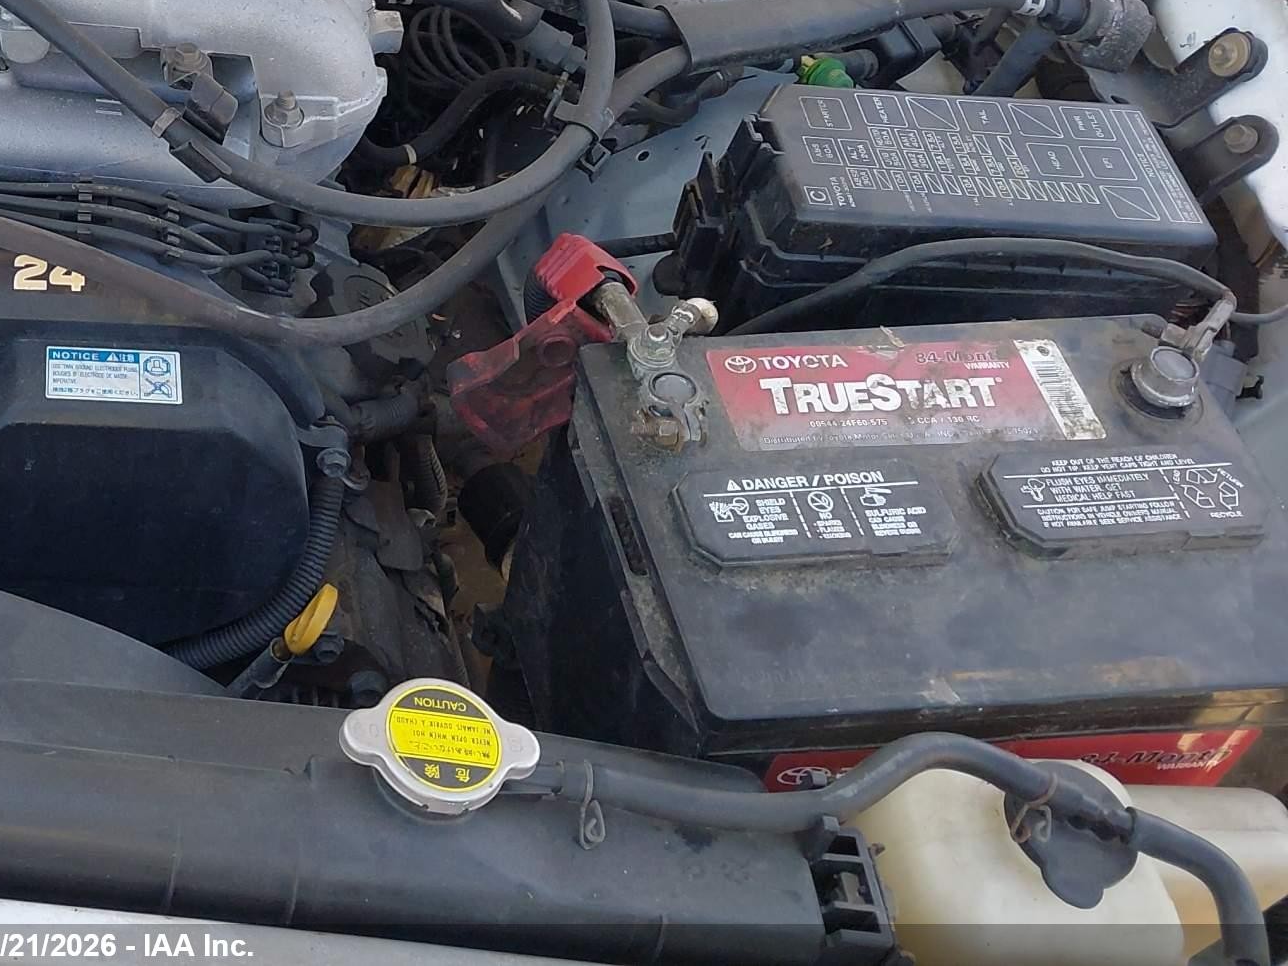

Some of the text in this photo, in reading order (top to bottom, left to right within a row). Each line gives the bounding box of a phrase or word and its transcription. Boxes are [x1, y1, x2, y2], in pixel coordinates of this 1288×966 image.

[816, 99, 834, 128] STARTER
[872, 96, 891, 124] HEATER
[978, 109, 990, 125] TAIL
[1073, 115, 1086, 131] PWR
[1086, 111, 1105, 138] OUTLET
[811, 143, 822, 158] ABS
[847, 145, 858, 161] ALT
[856, 144, 870, 162] 120A
[1047, 150, 1062, 170] HEAD
[811, 190, 828, 202] C
[829, 177, 844, 207] TOYOTA
[13, 254, 86, 292] 24
[52, 351, 100, 361] NOTICE
[758, 354, 849, 371] TOYOTA
[964, 361, 1010, 371] WARRANTY
[1111, 455, 1134, 463] REACH
[1144, 453, 1178, 461] CHILDREN
[742, 471, 885, 491] DANGER / POISON
[1045, 473, 1149, 486] FLUSH EYES IMMEDIATELY
[1049, 486, 1073, 495] WITH
[1105, 482, 1122, 491] GET
[755, 498, 786, 507] SHIELD
[1054, 490, 1136, 503] MEDICAL HELP FAST
[758, 506, 782, 514] EYES
[864, 508, 907, 517] SULFURIC
[1117, 502, 1149, 511] STARTING
[742, 513, 789, 522] EXPLOSIVE
[819, 512, 833, 520] NO
[1209, 511, 1245, 519] RECYCLE
[745, 522, 776, 530] GASES
[413, 696, 467, 712] CAUTION
[429, 732, 447, 741] WHEN
[451, 734, 467, 743] OPEN
[471, 737, 491, 746] NEVER
